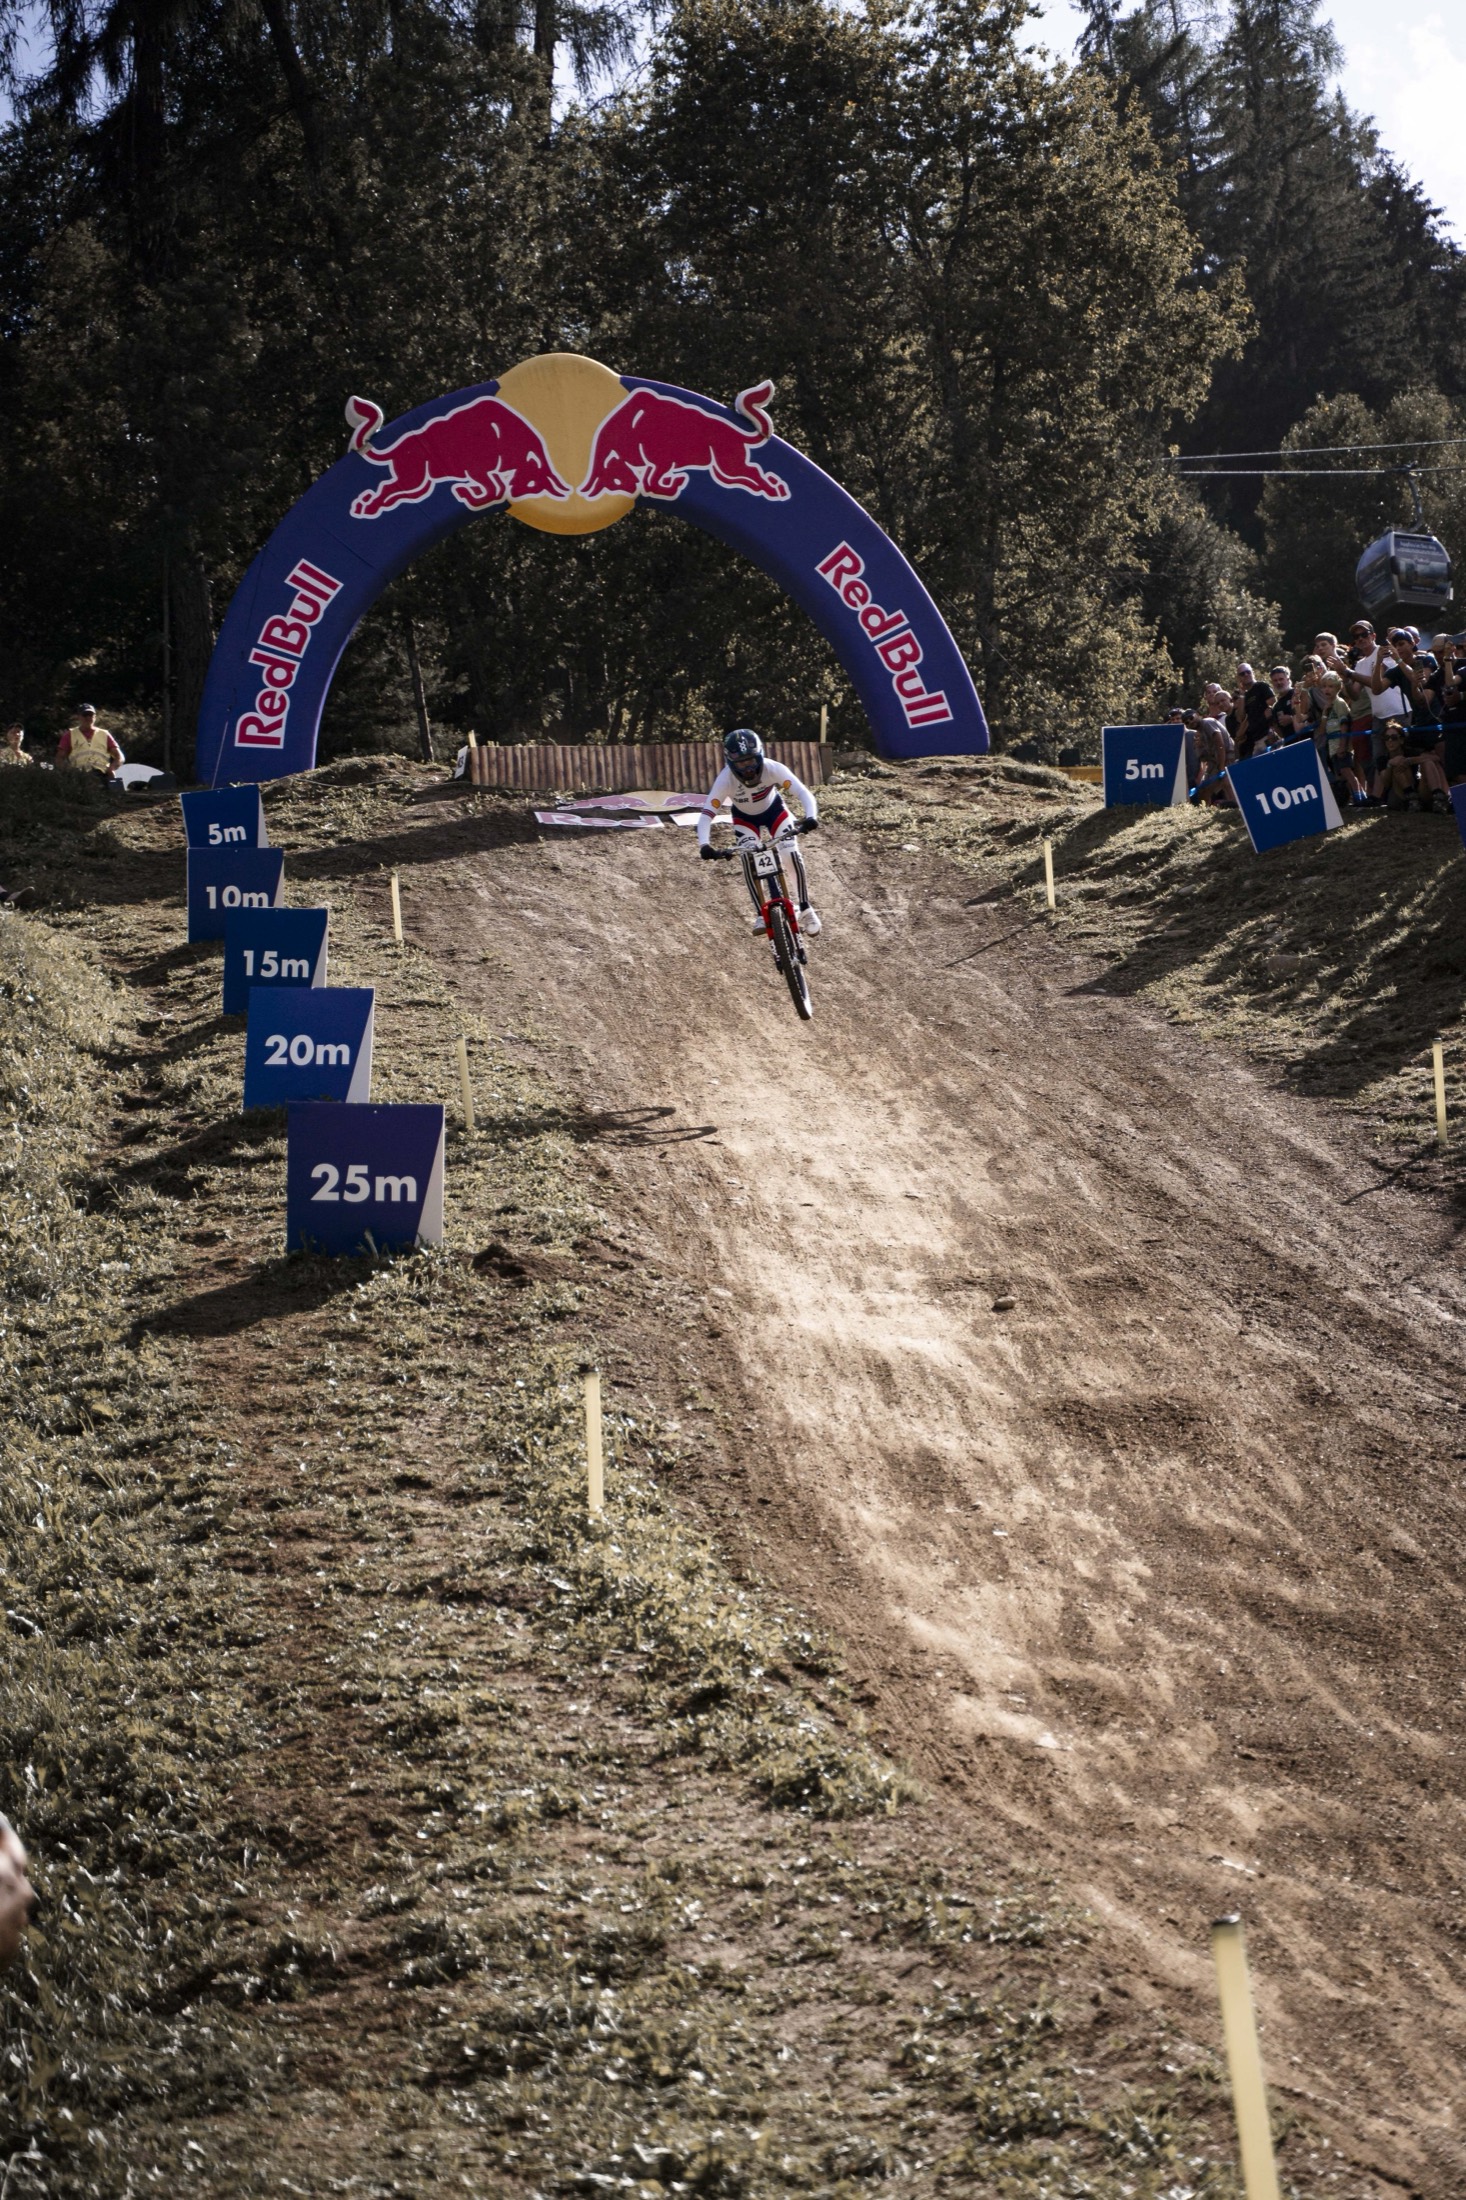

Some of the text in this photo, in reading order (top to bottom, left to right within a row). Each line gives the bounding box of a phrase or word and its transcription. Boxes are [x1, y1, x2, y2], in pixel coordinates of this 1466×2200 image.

[1125, 759, 1164, 780] 5m
[1256, 783, 1318, 815] 10m
[534, 811, 664, 828] Red
[208, 823, 247, 845] 5m
[758, 856, 773, 867] 42
[206, 885, 269, 909] 10m
[243, 950, 310, 978] 15m
[264, 1034, 351, 1066] 20m
[310, 1163, 418, 1203] 25m
